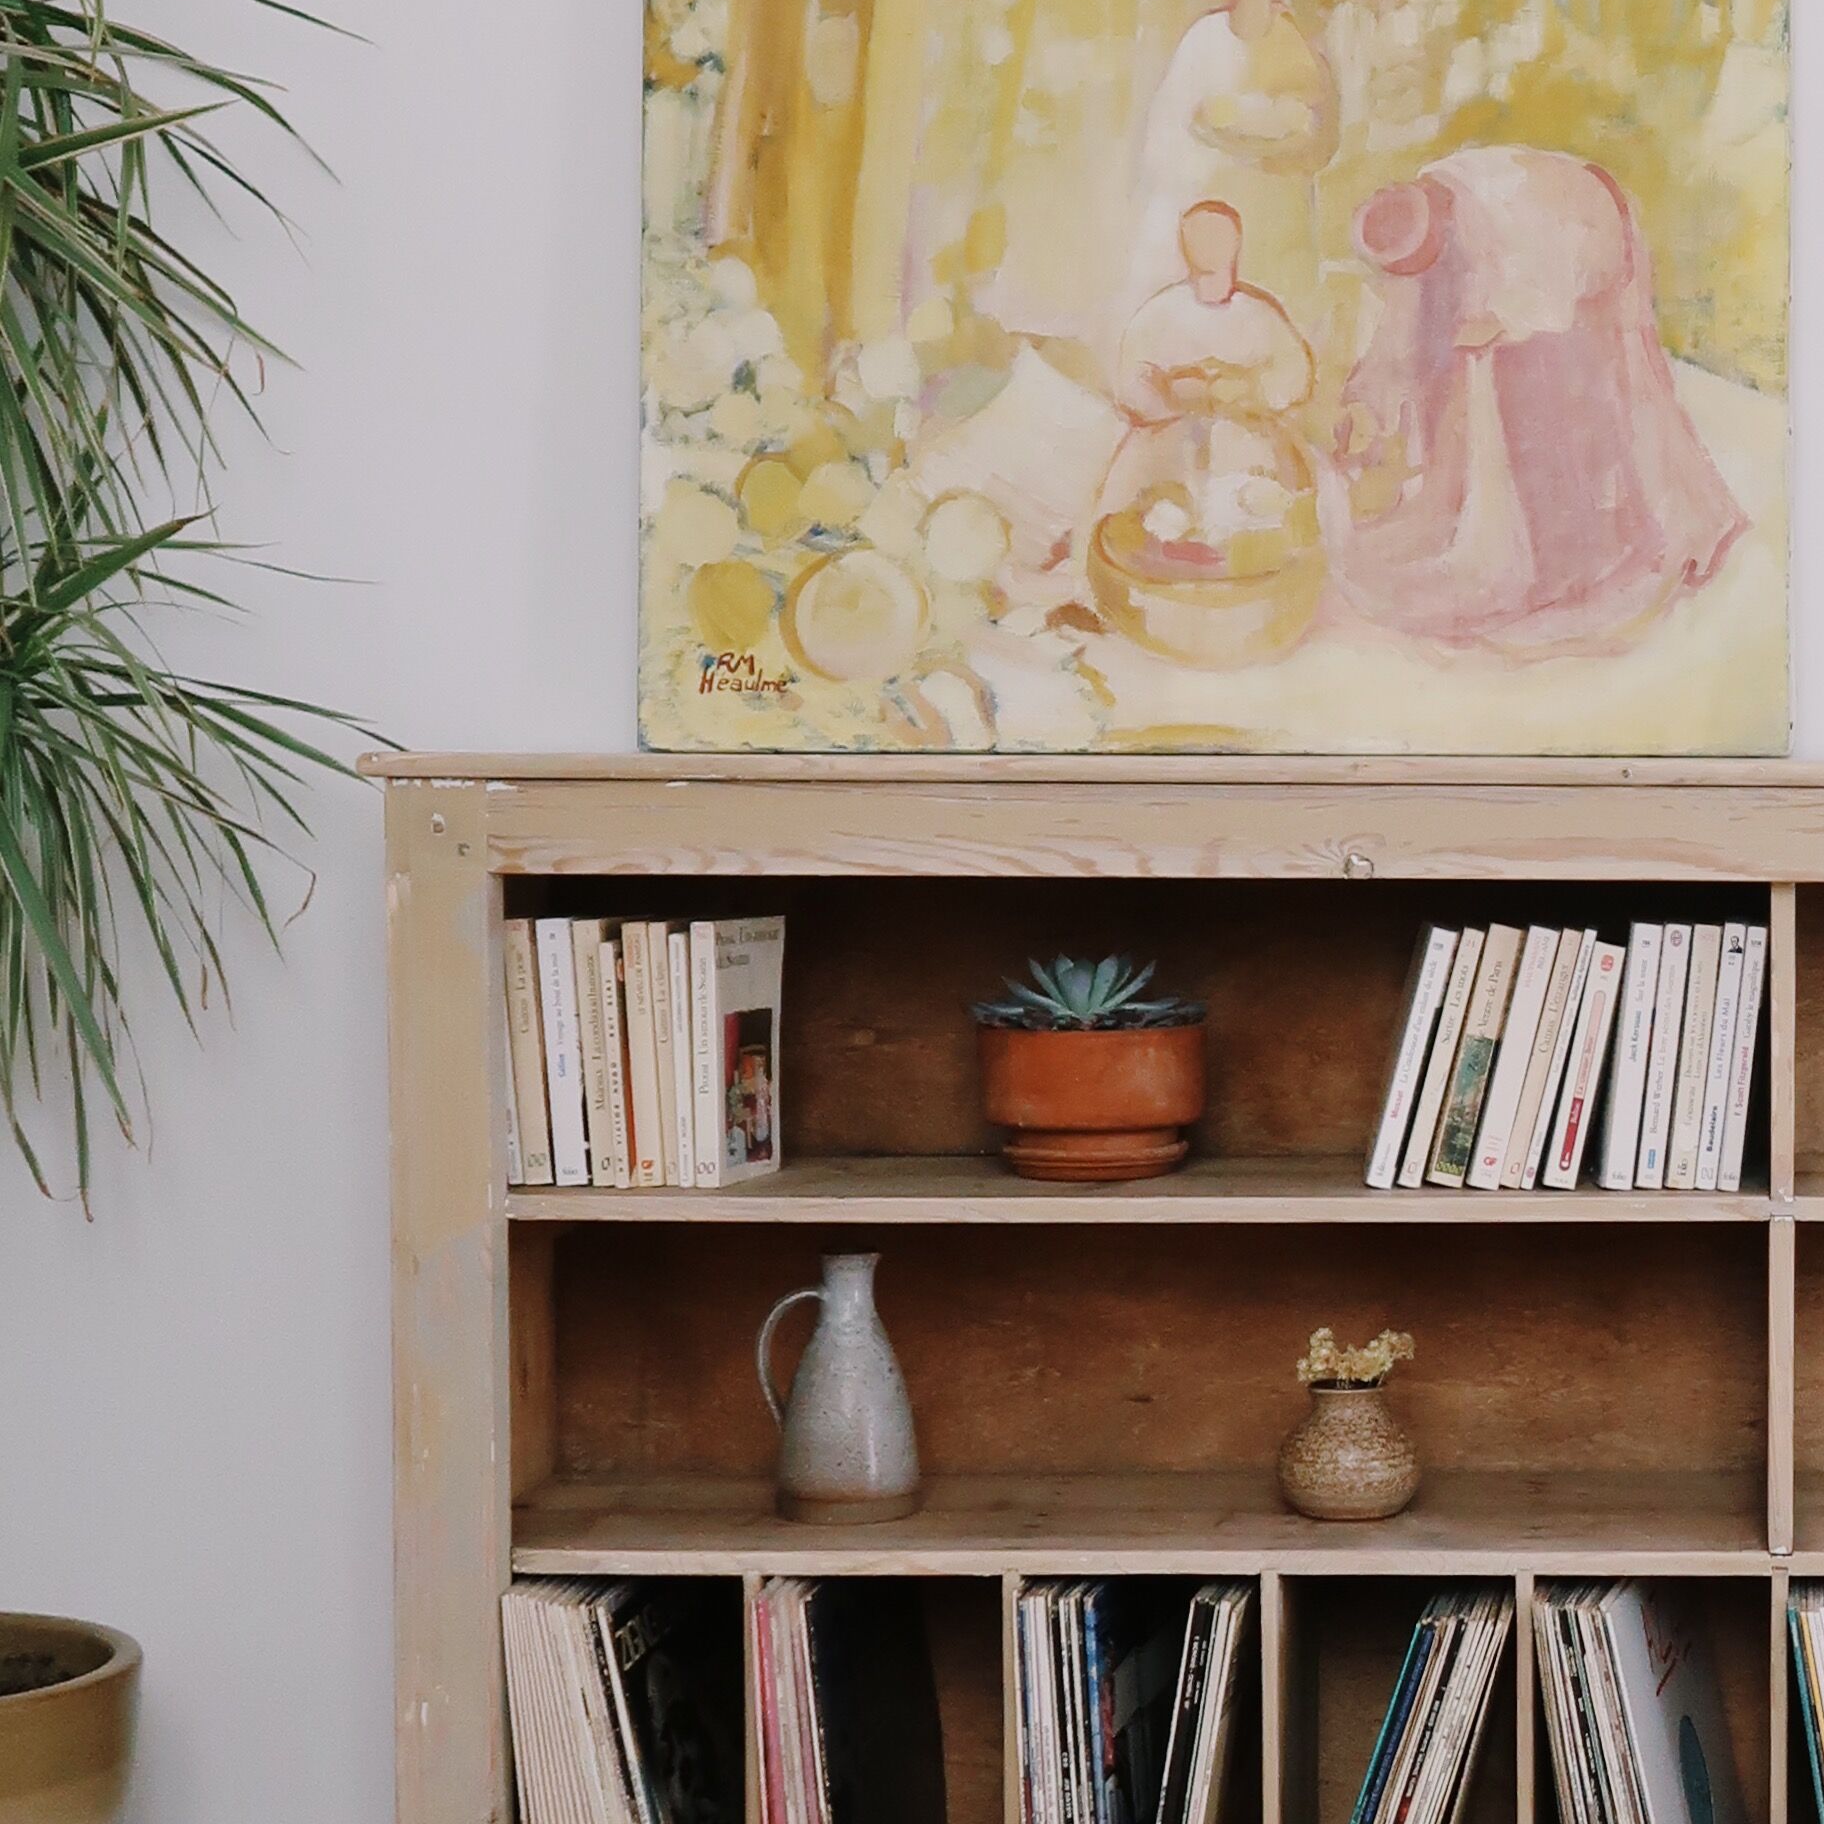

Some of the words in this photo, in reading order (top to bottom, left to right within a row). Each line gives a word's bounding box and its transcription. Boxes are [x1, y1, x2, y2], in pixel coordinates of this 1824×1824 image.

[1484, 983, 1497, 998] de
[1721, 997, 1731, 1016] Mal
[1720, 1017, 1729, 1031] du
[1628, 1043, 1639, 1063] Jack
[1714, 1063, 1724, 1080] Les
[1737, 1045, 1750, 1086] Fitzgerald
[1735, 1086, 1745, 1108] Scott
[614, 1104, 622, 1144] VICTOR
[1705, 1105, 1719, 1153] Baudelaire
